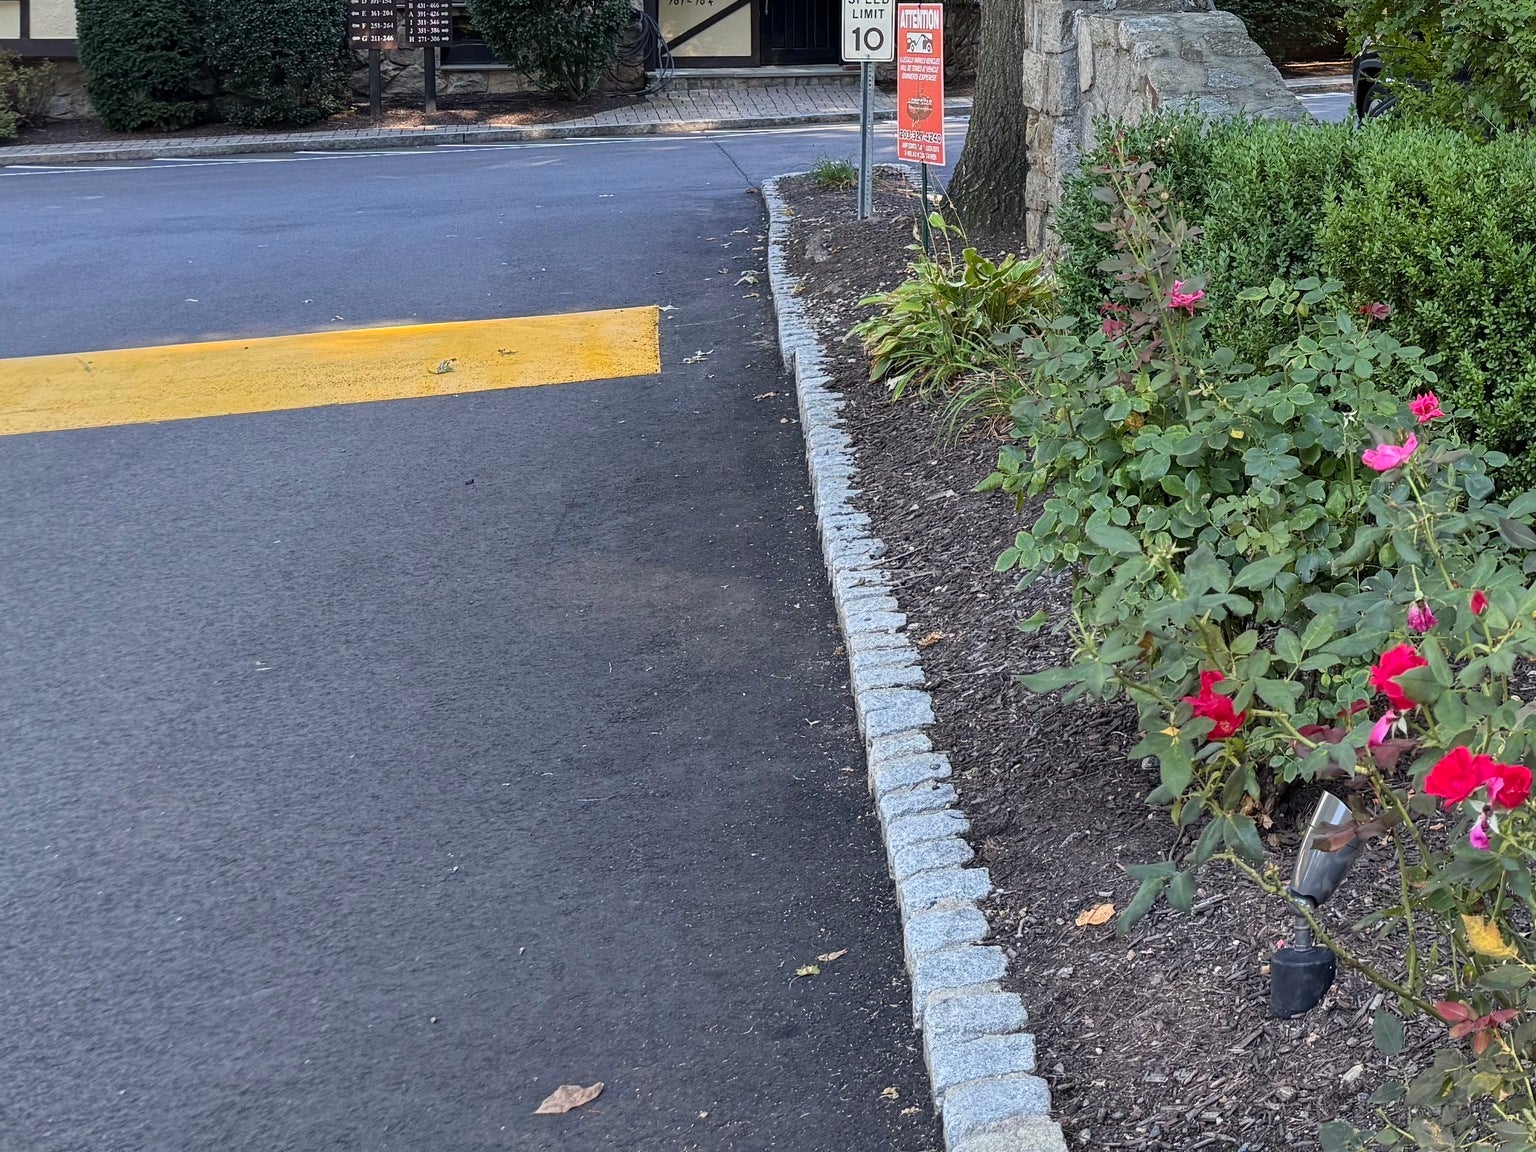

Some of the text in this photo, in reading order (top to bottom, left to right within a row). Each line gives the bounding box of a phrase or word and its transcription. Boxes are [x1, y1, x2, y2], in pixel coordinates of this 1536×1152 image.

[852, 9, 885, 19] LIMIT
[900, 9, 940, 29] ATTENTION
[852, 27, 884, 51] 10
